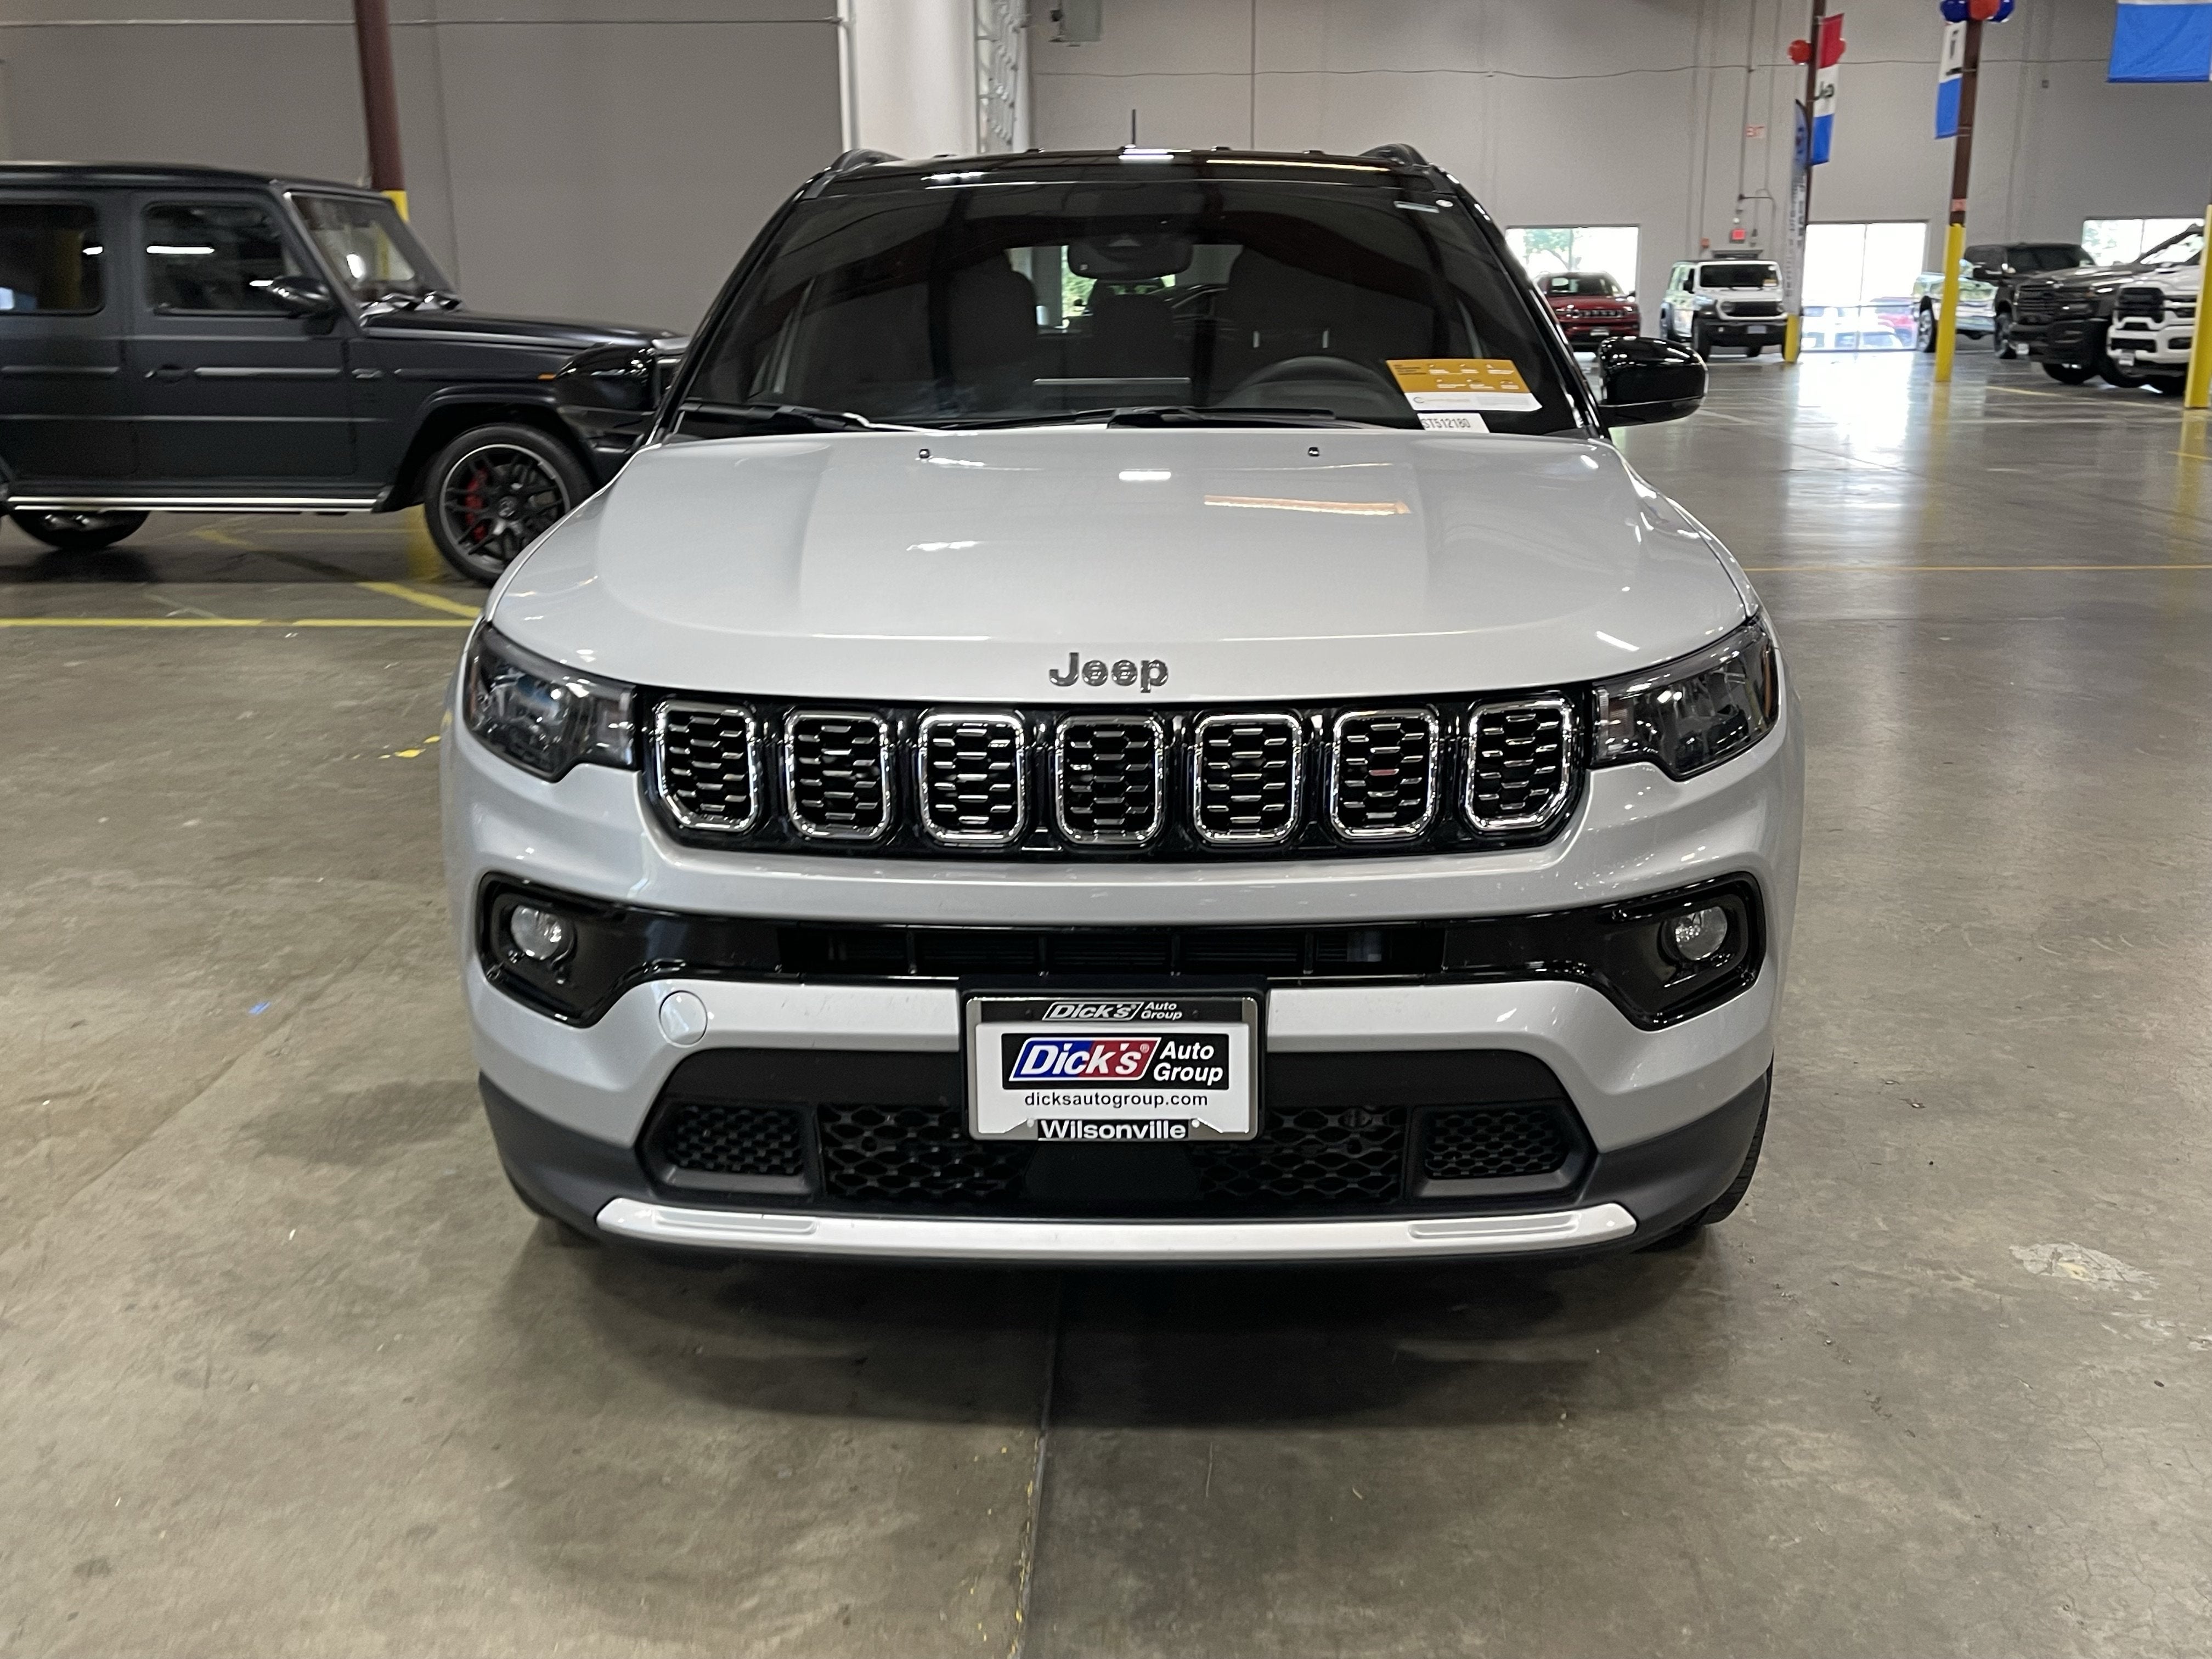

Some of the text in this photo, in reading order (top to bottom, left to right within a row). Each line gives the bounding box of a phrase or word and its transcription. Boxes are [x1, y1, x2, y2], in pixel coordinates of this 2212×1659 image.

[1048, 652, 1169, 693] Jeep
[1141, 1010, 1183, 1020] Group
[1145, 1002, 1177, 1011] Auto
[1160, 1041, 1214, 1060] Auto
[1153, 1063, 1223, 1086] Group
[1025, 1092, 1207, 1108] dicksautogroup.com
[1041, 1120, 1186, 1139] Wilsonville
